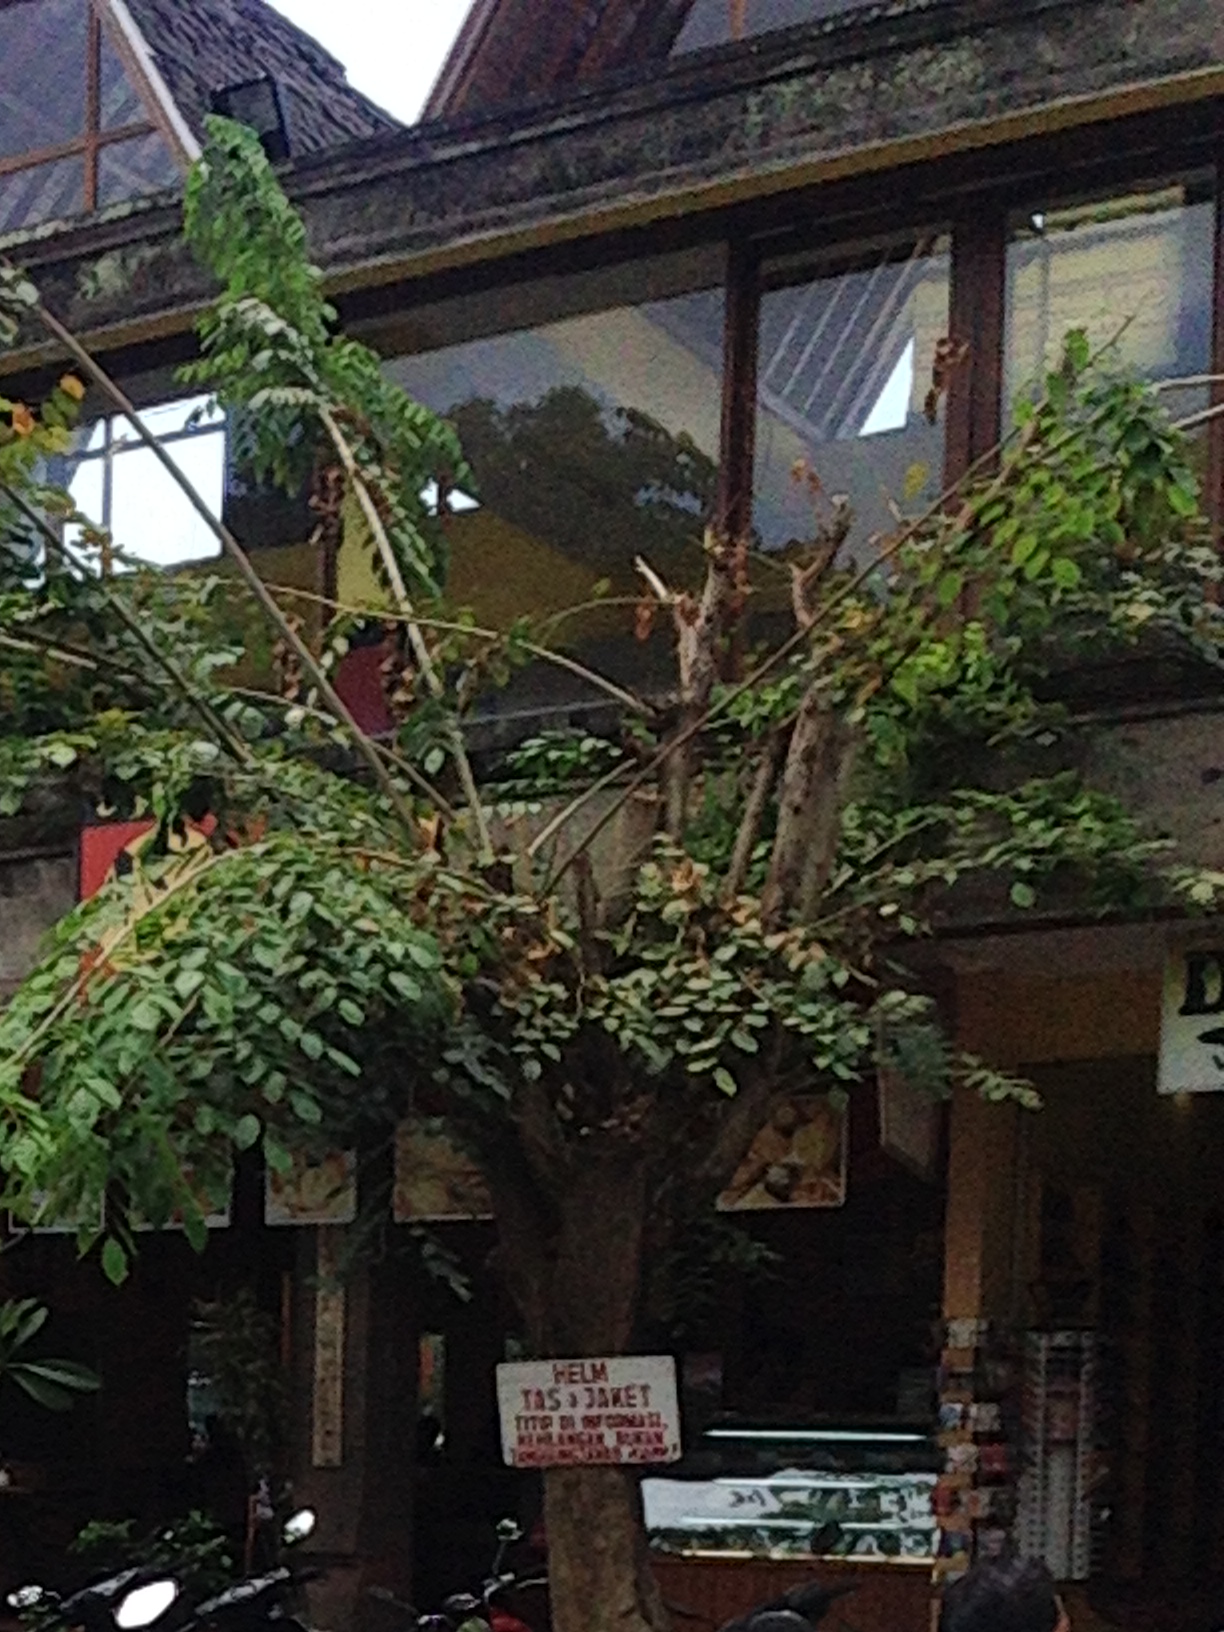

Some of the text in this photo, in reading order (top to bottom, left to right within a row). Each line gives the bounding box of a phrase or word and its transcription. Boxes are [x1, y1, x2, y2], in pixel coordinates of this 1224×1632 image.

[553, 1361, 609, 1385] HELM
[520, 1387, 562, 1411] TAS
[584, 1383, 652, 1409] JAKET
